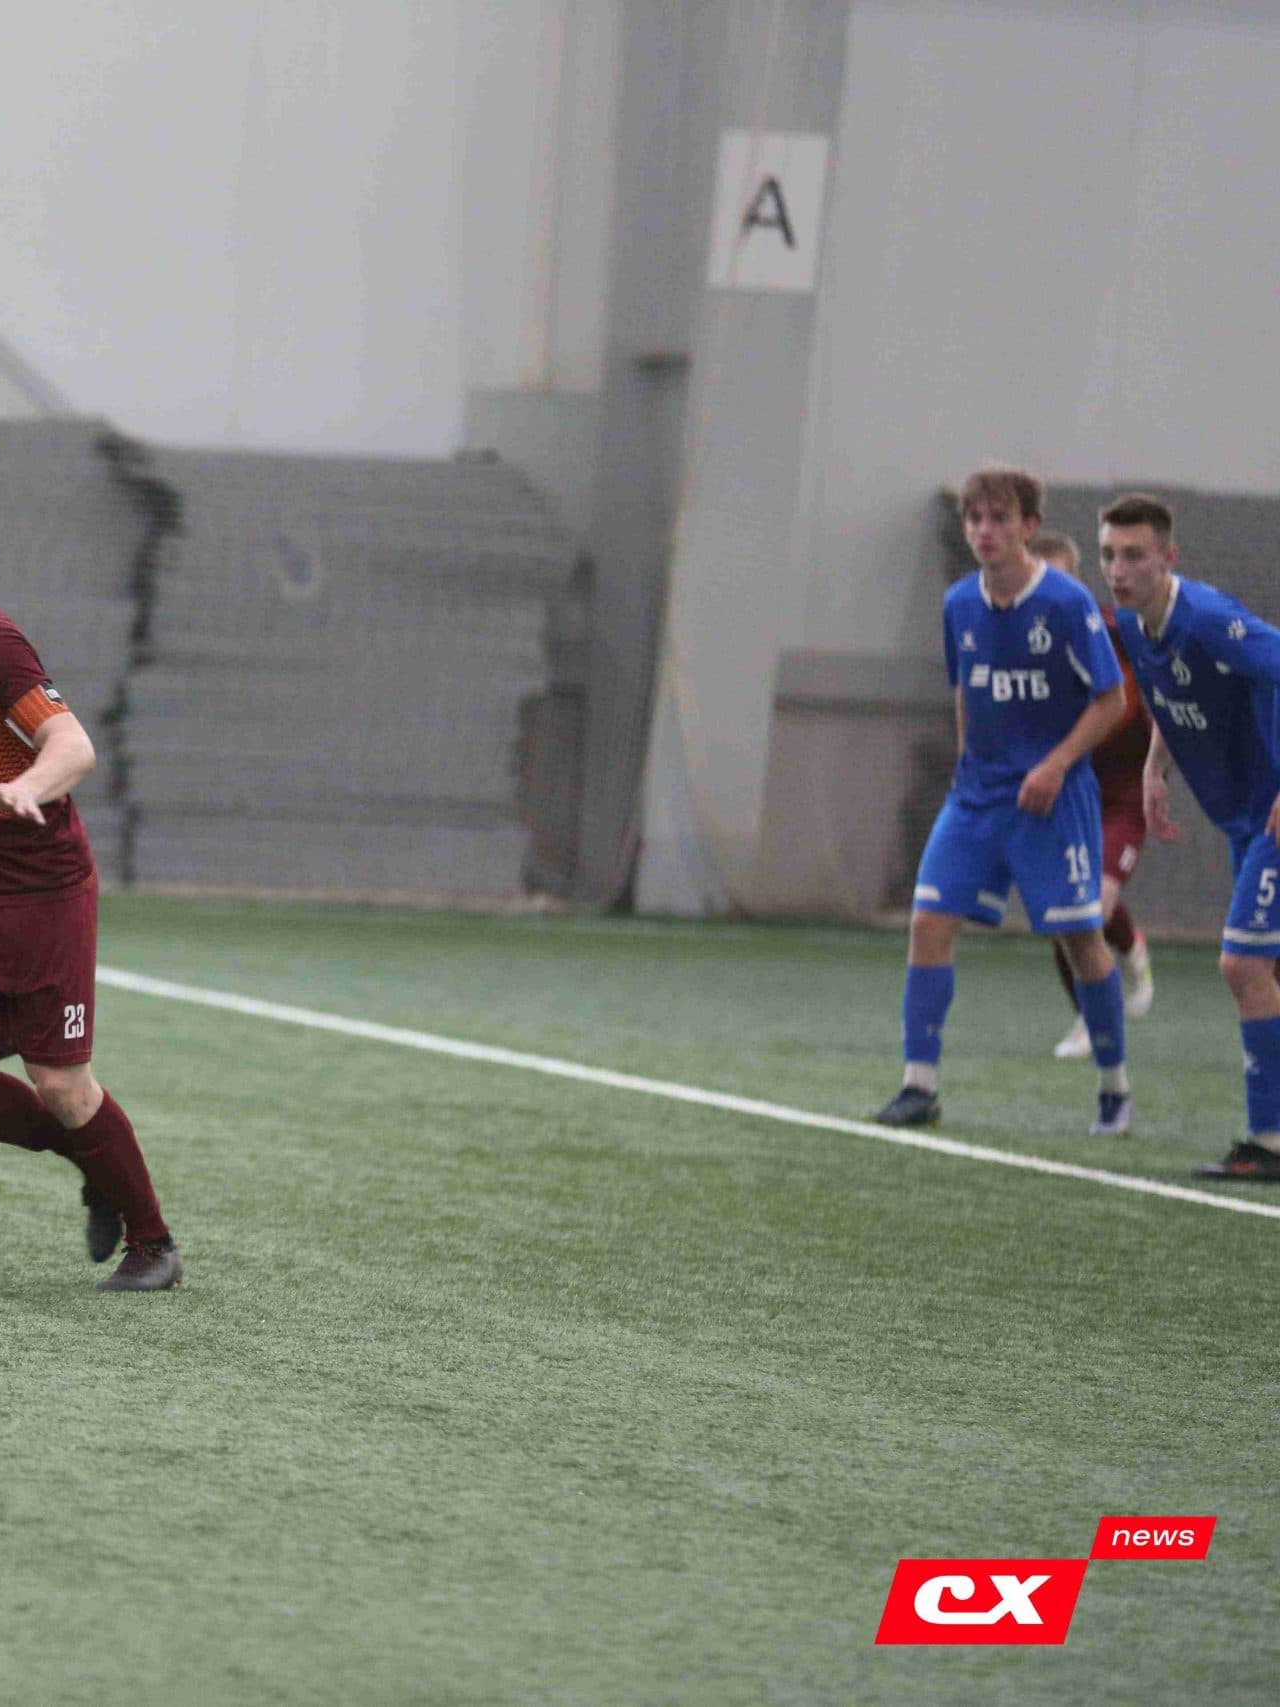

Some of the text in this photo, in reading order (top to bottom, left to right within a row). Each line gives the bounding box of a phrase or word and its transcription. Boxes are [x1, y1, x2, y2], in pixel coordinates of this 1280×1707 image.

[740, 176, 799, 251] A
[992, 670, 1051, 702] ВТБ
[1256, 868, 1278, 907] 5
[64, 1003, 86, 1039] 23
